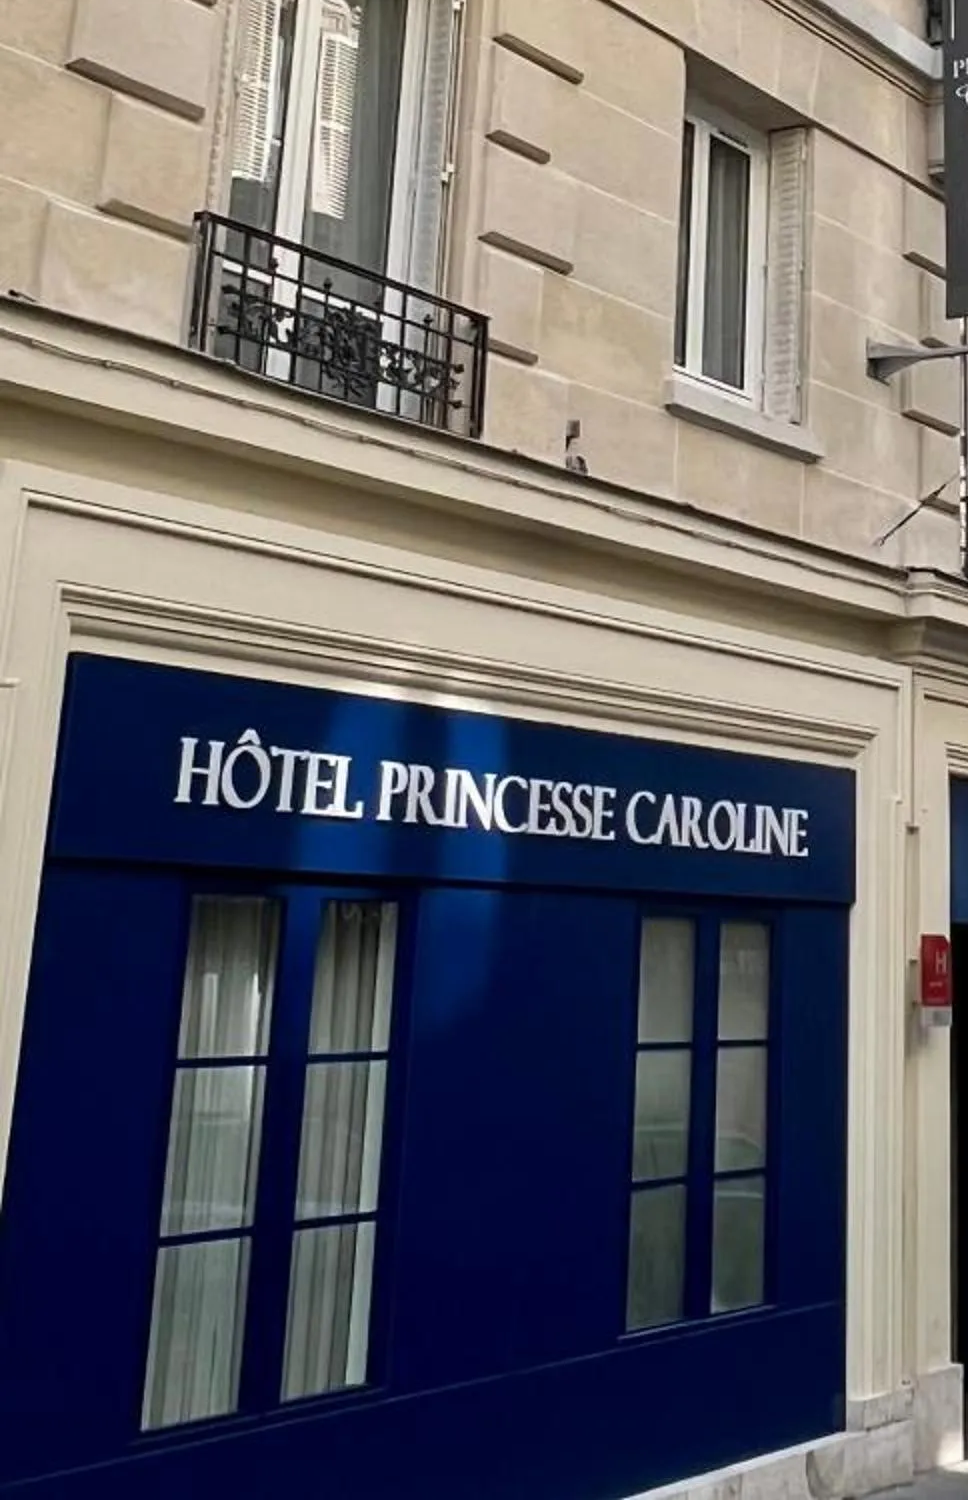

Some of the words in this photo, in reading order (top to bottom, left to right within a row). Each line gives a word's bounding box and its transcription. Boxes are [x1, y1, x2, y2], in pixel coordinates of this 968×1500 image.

[173, 728, 364, 819] HÔTEL
[375, 760, 617, 841] PRINCESSE
[625, 790, 809, 858] CAROLINE
